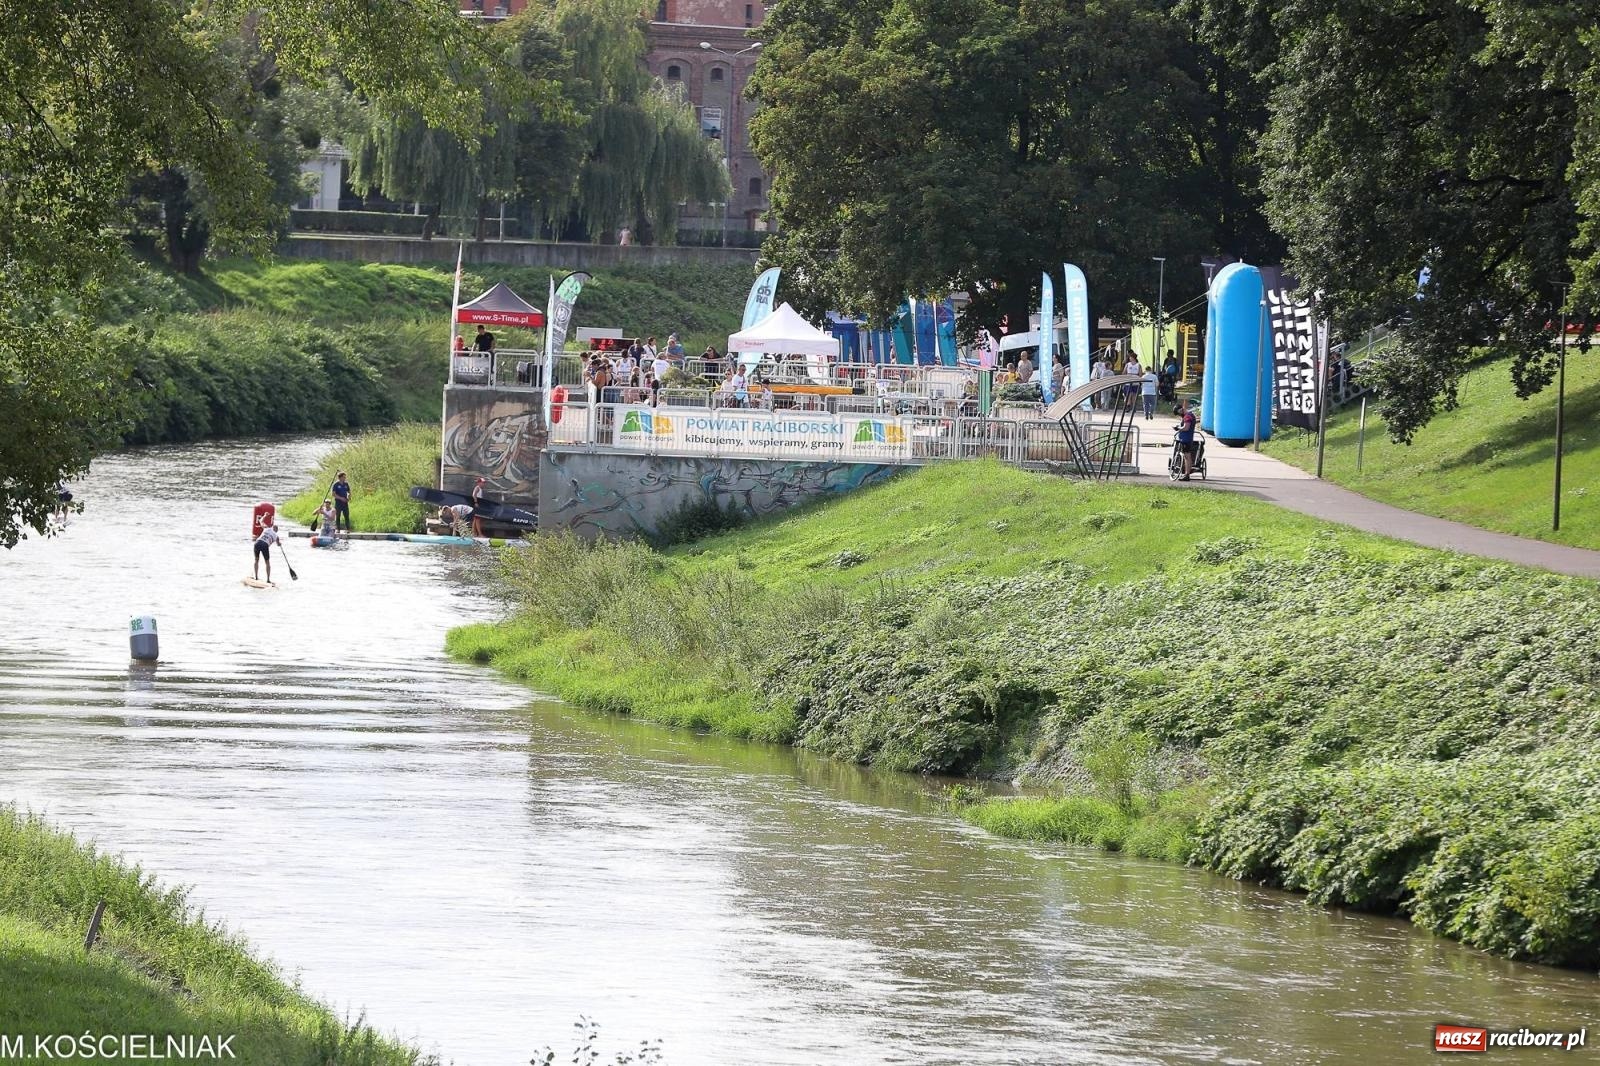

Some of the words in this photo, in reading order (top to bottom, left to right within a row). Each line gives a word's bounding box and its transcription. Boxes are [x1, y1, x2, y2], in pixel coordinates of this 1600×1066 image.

[472, 313, 529, 324] www.S-Time.pl
[686, 418, 748, 431] POWIAT
[752, 420, 844, 435] RACIBORSKI
[685, 434, 743, 446] kibicujemy,
[749, 437, 808, 449] wspieramy,
[811, 440, 844, 450] gramy
